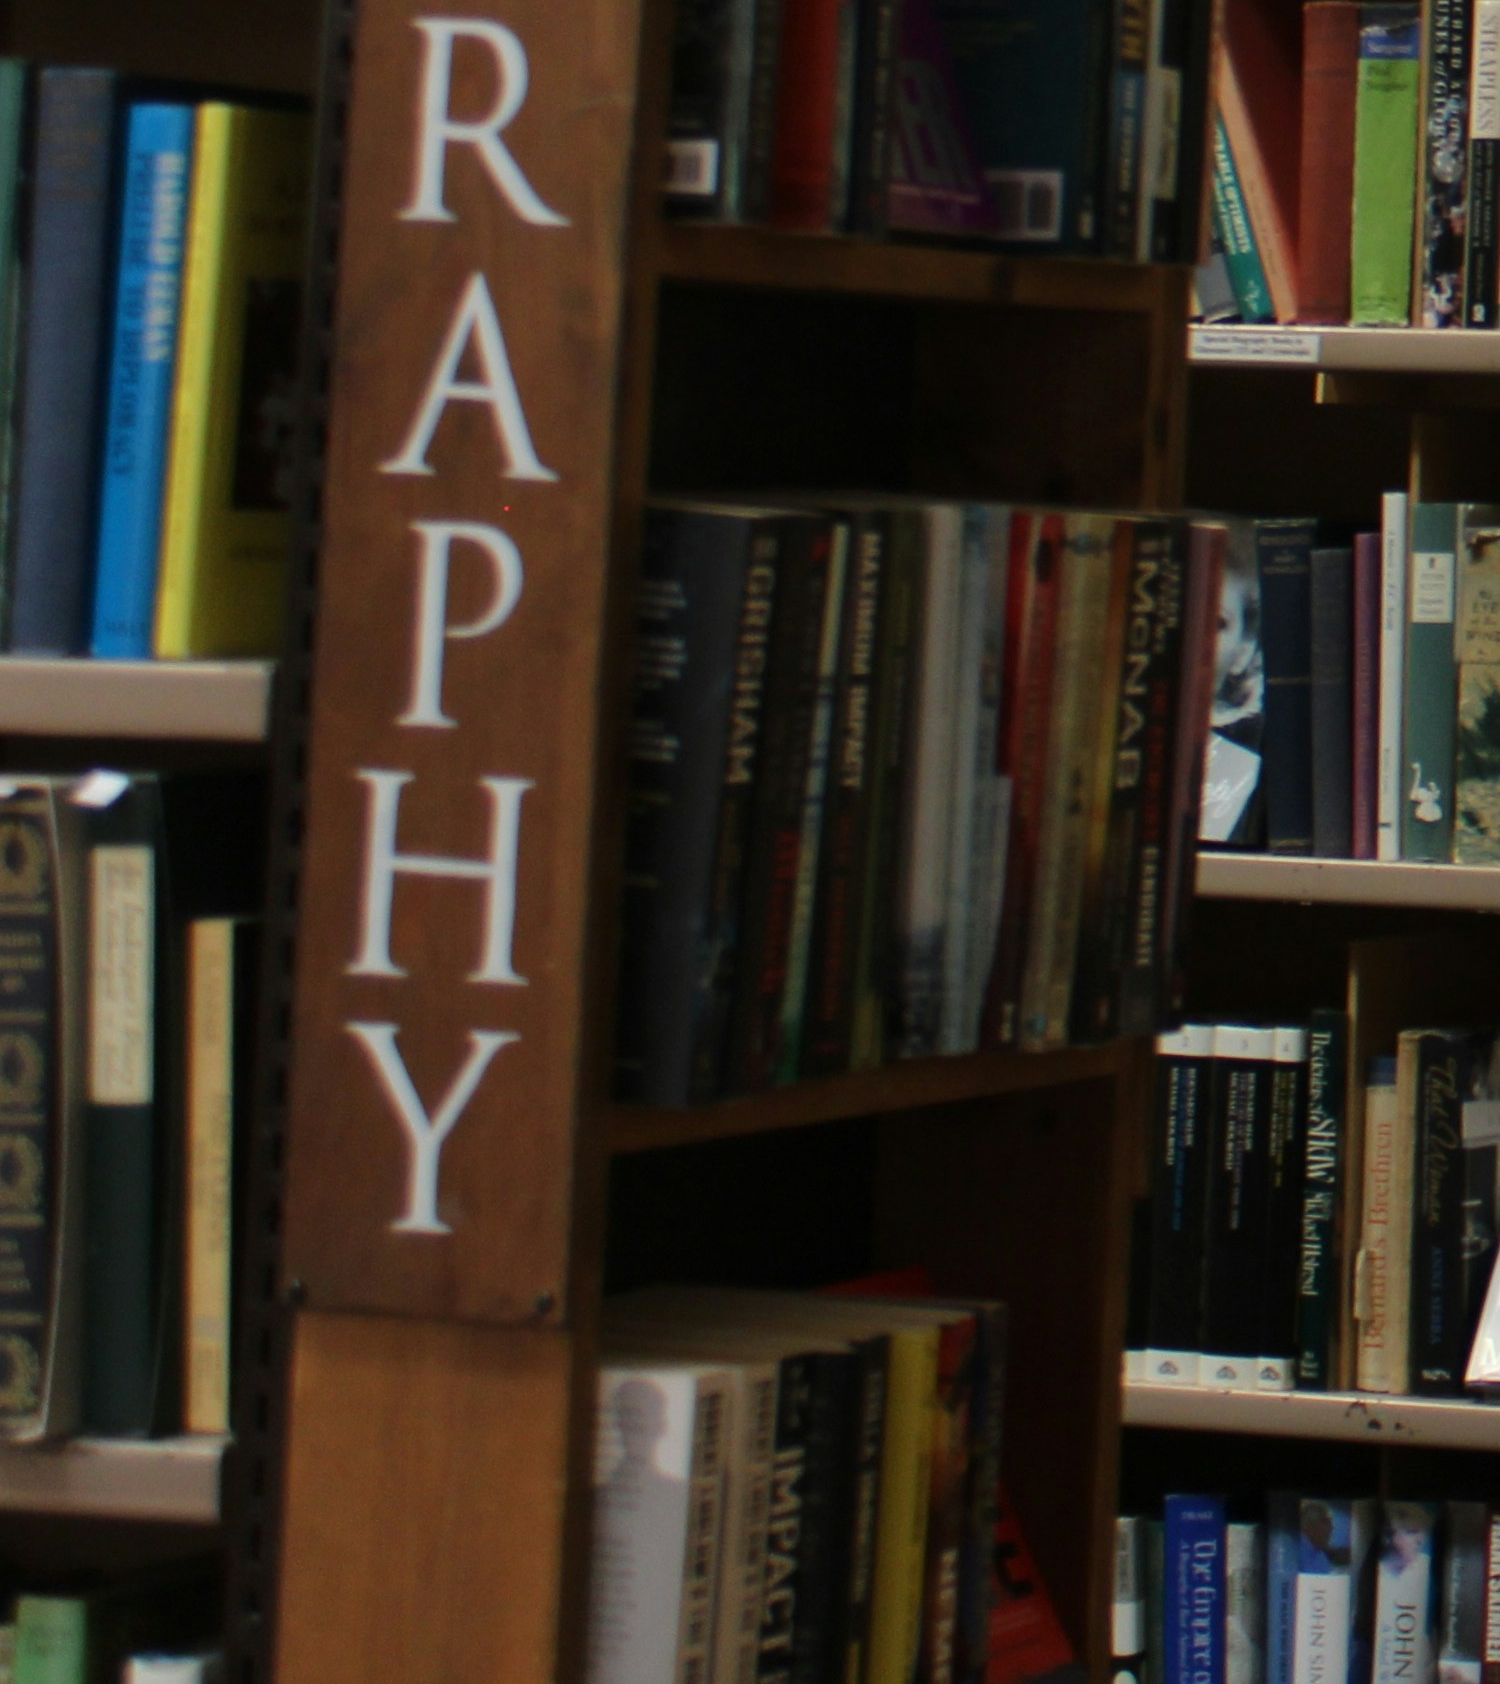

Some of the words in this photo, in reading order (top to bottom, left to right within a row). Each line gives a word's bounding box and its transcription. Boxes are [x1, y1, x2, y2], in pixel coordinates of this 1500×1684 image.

[1429, 81, 1449, 152] GLORY
[1476, 16, 1500, 132] STRAPLESS
[851, 532, 882, 675] MAXIMUM
[723, 565, 776, 786] GRISHAM
[840, 683, 869, 791] IMPACT
[1427, 1065, 1461, 1120] That
[1304, 1116, 1338, 1184] SHAW
[1368, 1120, 1393, 1230] Brethren
[1426, 1132, 1458, 1228] Woman
[1301, 1191, 1324, 1236] Michael
[1308, 1589, 1328, 1648] JOHN
[1393, 1602, 1418, 1677] JOHN
